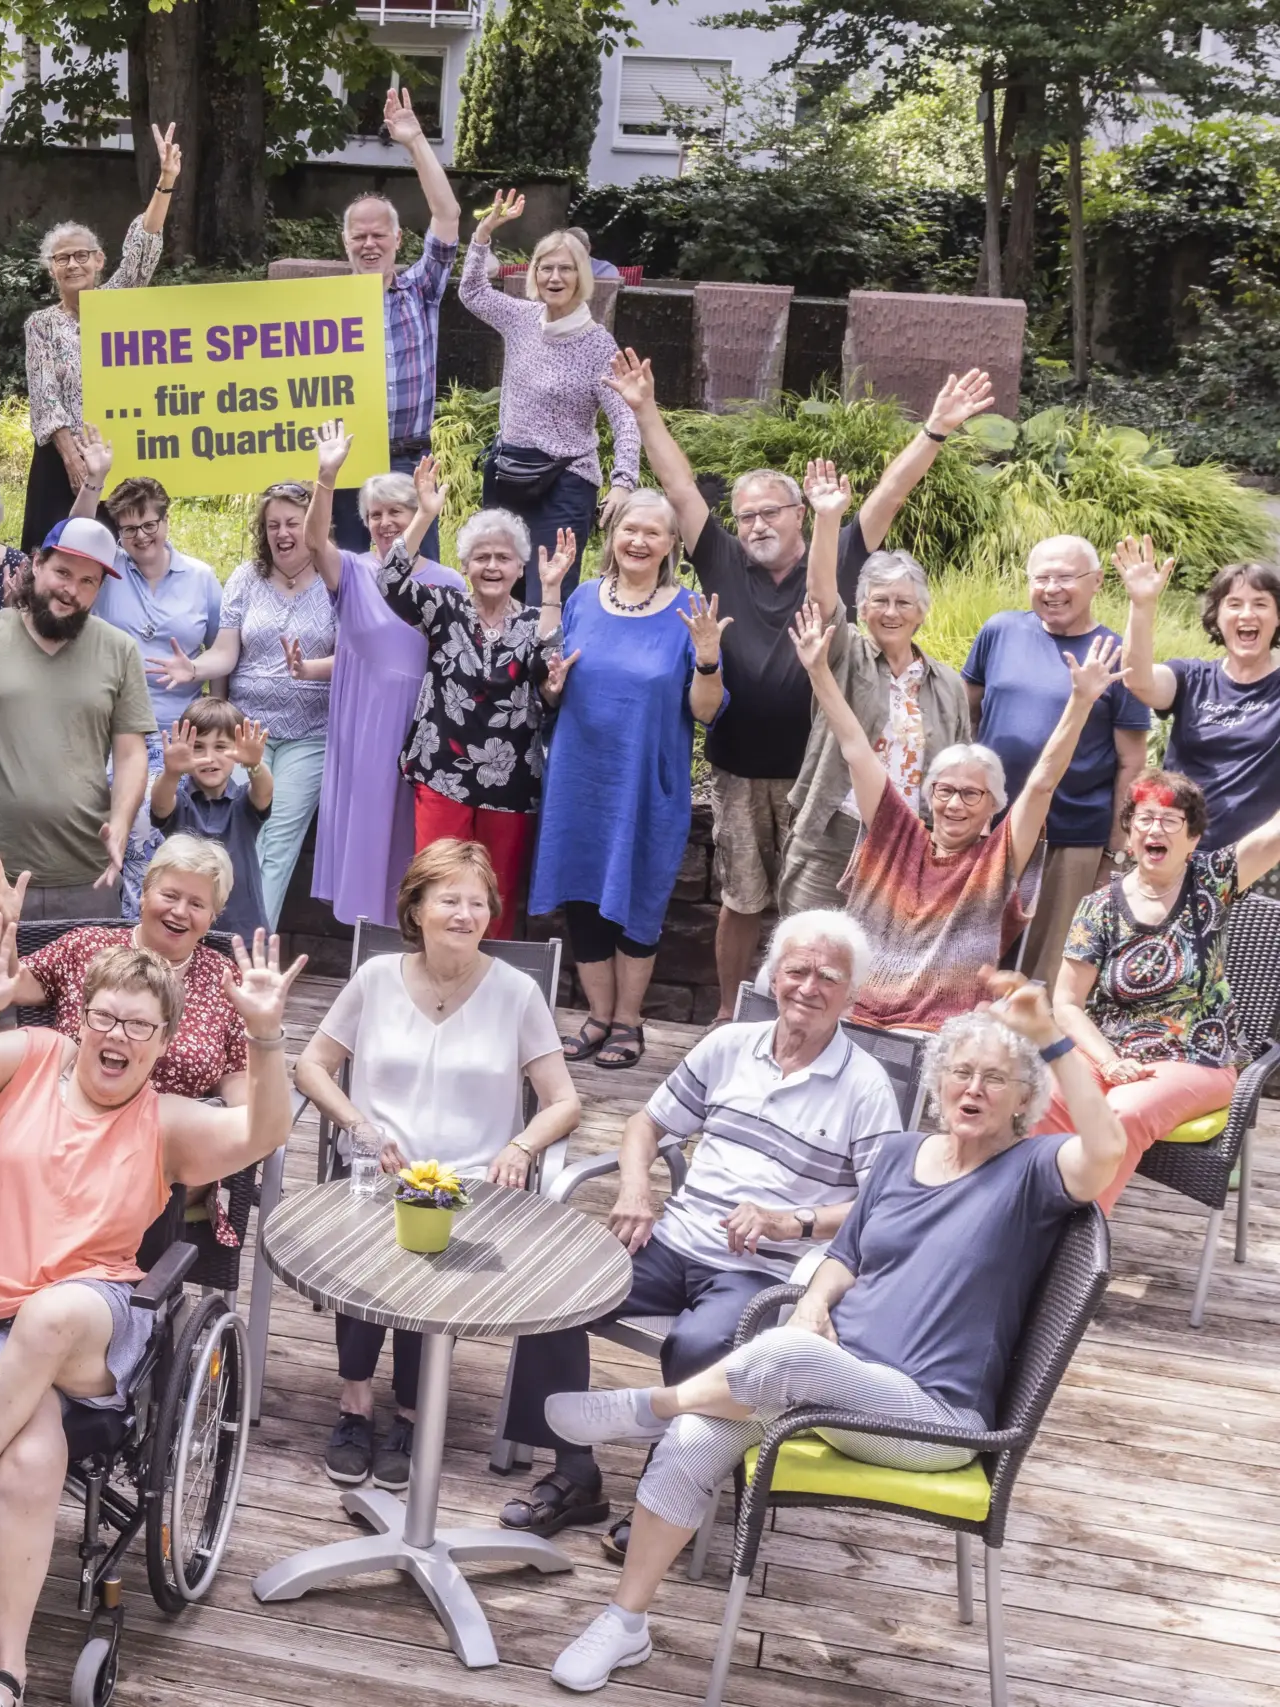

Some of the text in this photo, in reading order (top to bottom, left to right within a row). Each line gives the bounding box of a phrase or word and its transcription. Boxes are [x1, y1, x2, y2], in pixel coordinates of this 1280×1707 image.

[101, 317, 365, 367] IHRE SPENDE
[154, 384, 205, 416] für
[216, 382, 279, 414] das
[287, 374, 355, 409] WIR
[136, 429, 180, 460] im
